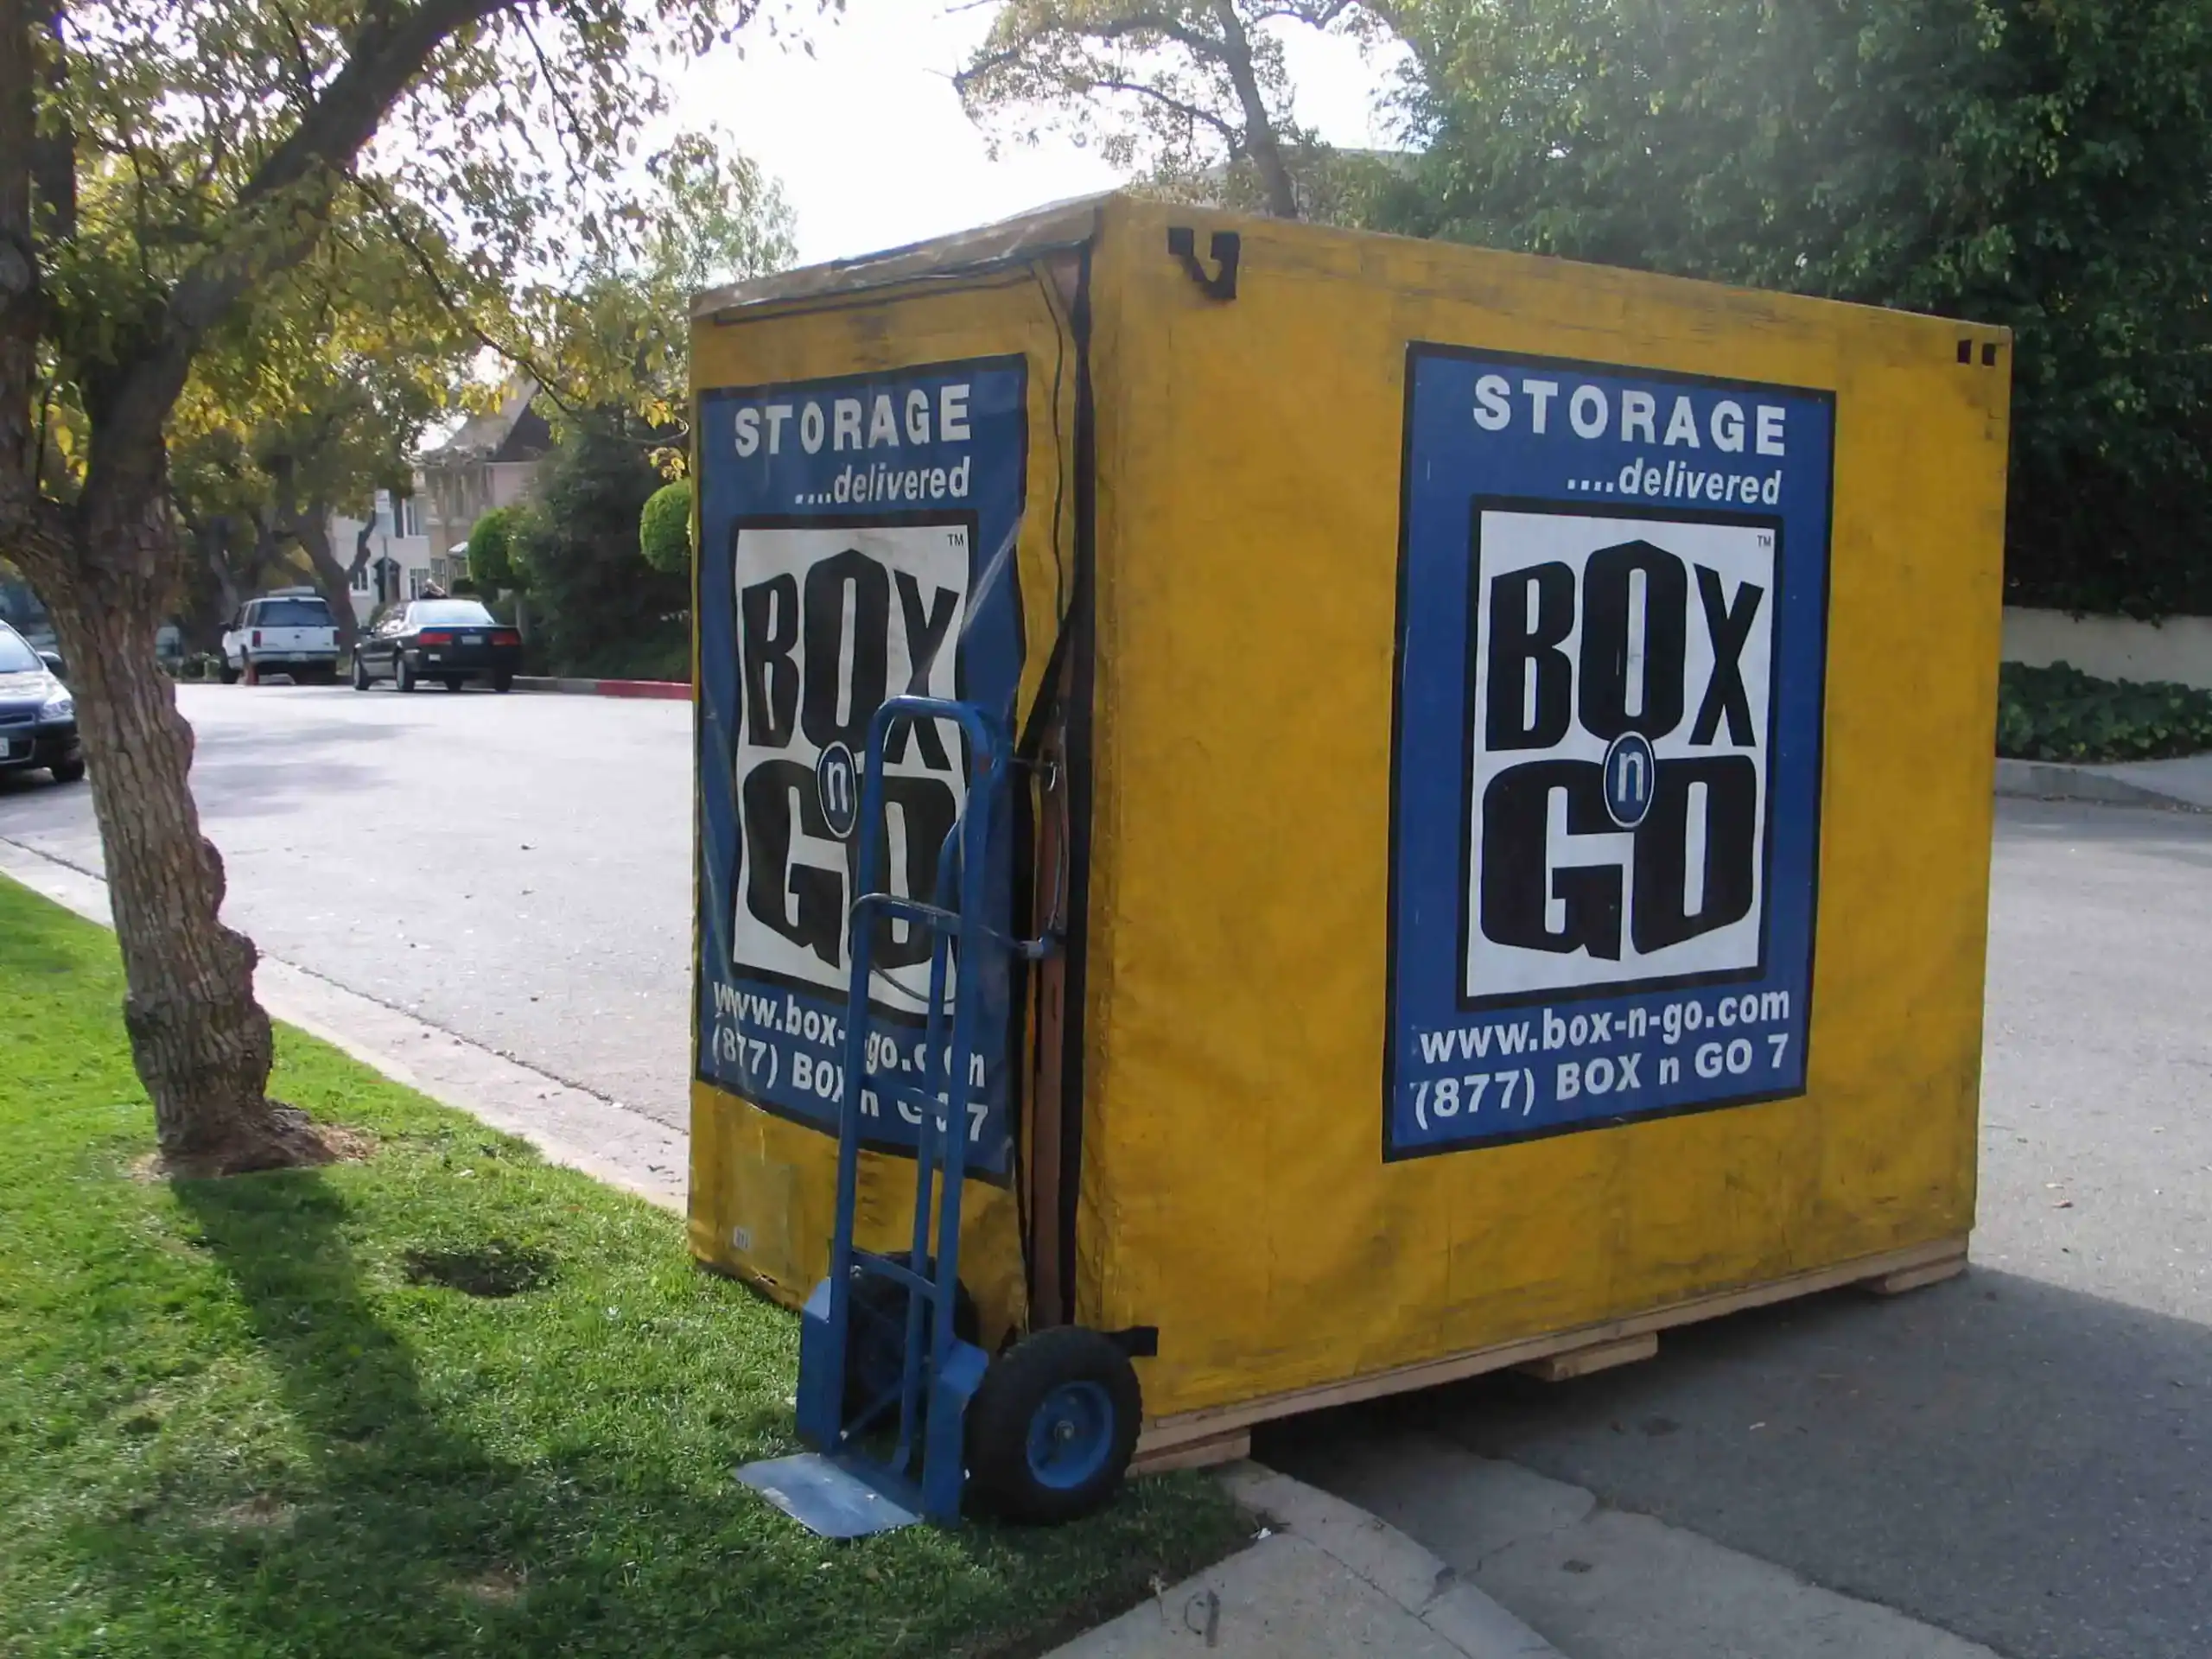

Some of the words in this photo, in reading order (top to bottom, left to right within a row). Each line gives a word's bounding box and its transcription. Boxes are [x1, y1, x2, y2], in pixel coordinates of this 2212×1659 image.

[734, 384, 971, 458] STORAGE
[1473, 374, 1786, 457] STORAGE
[1567, 456, 1782, 505] ....delivered
[947, 533, 964, 548] TM
[1757, 534, 1772, 549] TM
[741, 548, 960, 772] BOX
[1484, 539, 1764, 751] BOX
[827, 761, 849, 813] n
[1618, 750, 1646, 802] n
[743, 759, 957, 969] GO
[1480, 754, 1758, 962] GO
[1420, 989, 1790, 1064] www.box-n-go.com
[712, 1023, 779, 1090] (877)
[860, 1089, 880, 1117] n
[966, 1103, 988, 1142] 7
[1413, 1067, 1535, 1130] (877)
[1556, 1052, 1643, 1102] BOX
[1659, 1055, 1681, 1085] n
[1694, 1038, 1753, 1079] GO
[1767, 1033, 1789, 1069] 7
